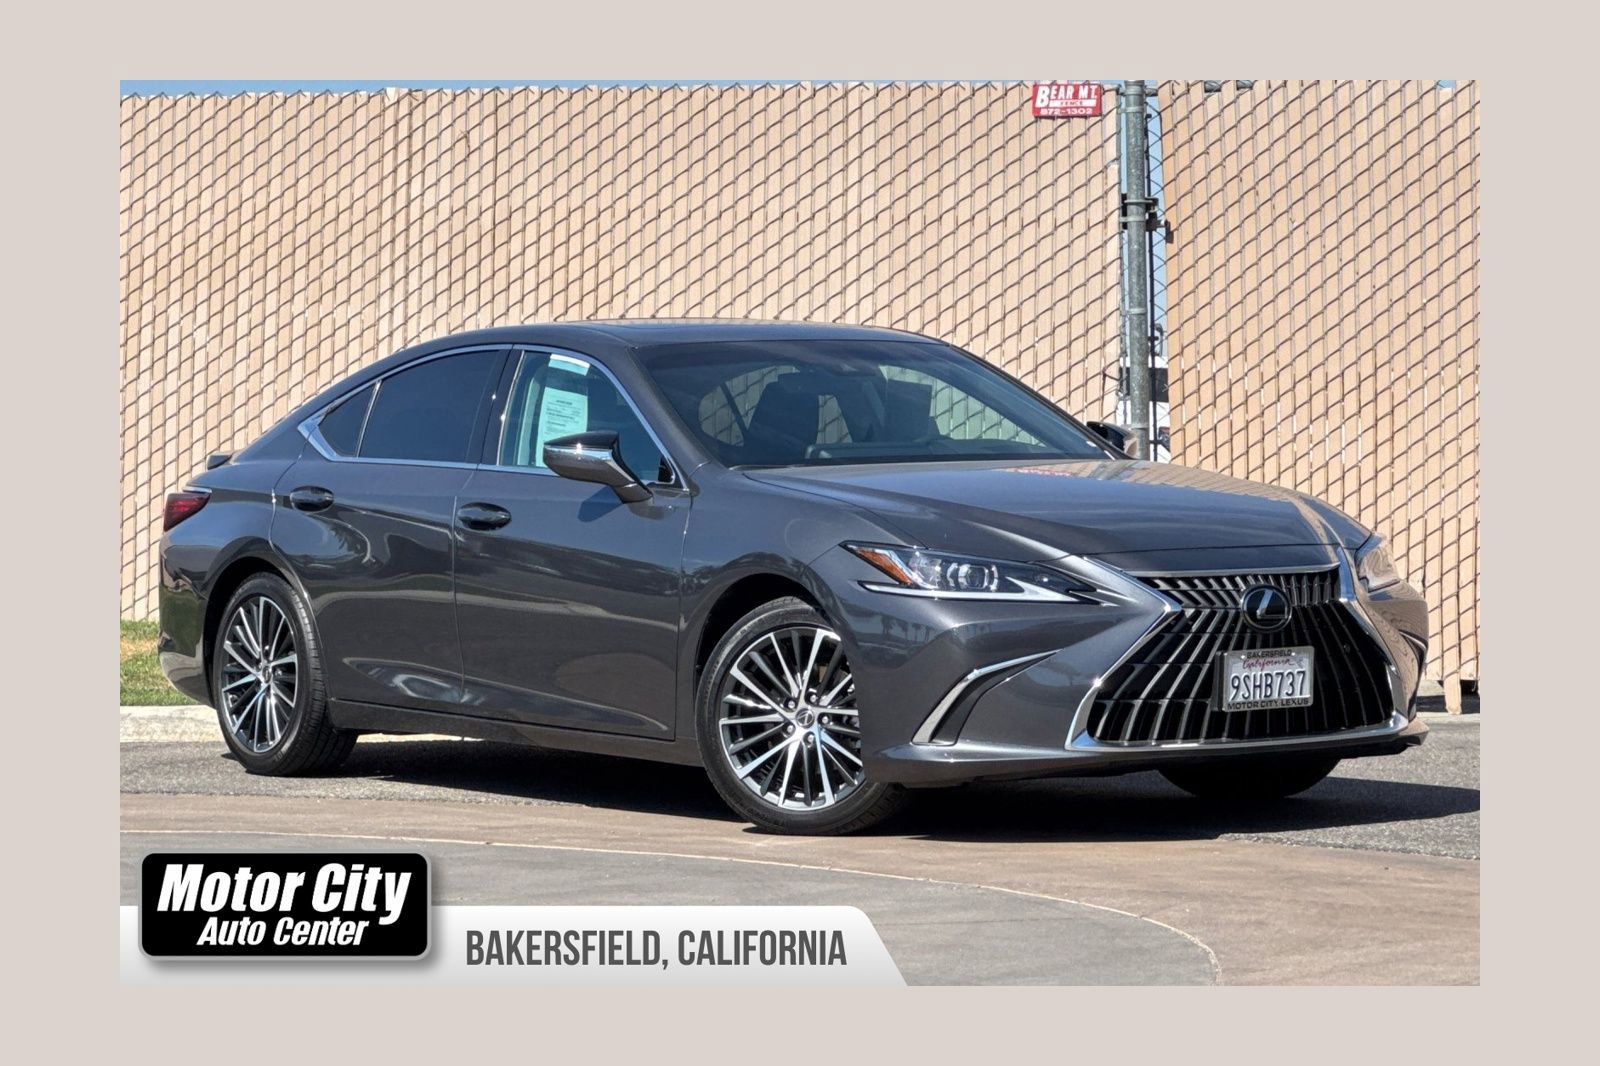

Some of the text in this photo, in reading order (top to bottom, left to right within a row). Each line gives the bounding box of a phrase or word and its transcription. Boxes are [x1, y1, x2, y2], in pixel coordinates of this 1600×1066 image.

[1035, 85, 1075, 108] BEAR
[1246, 649, 1292, 659] BAKERSFIELD
[1243, 658, 1295, 671] California
[1230, 670, 1306, 701] 9SHB737
[1227, 697, 1309, 710] MOTOR CITY LEXUS
